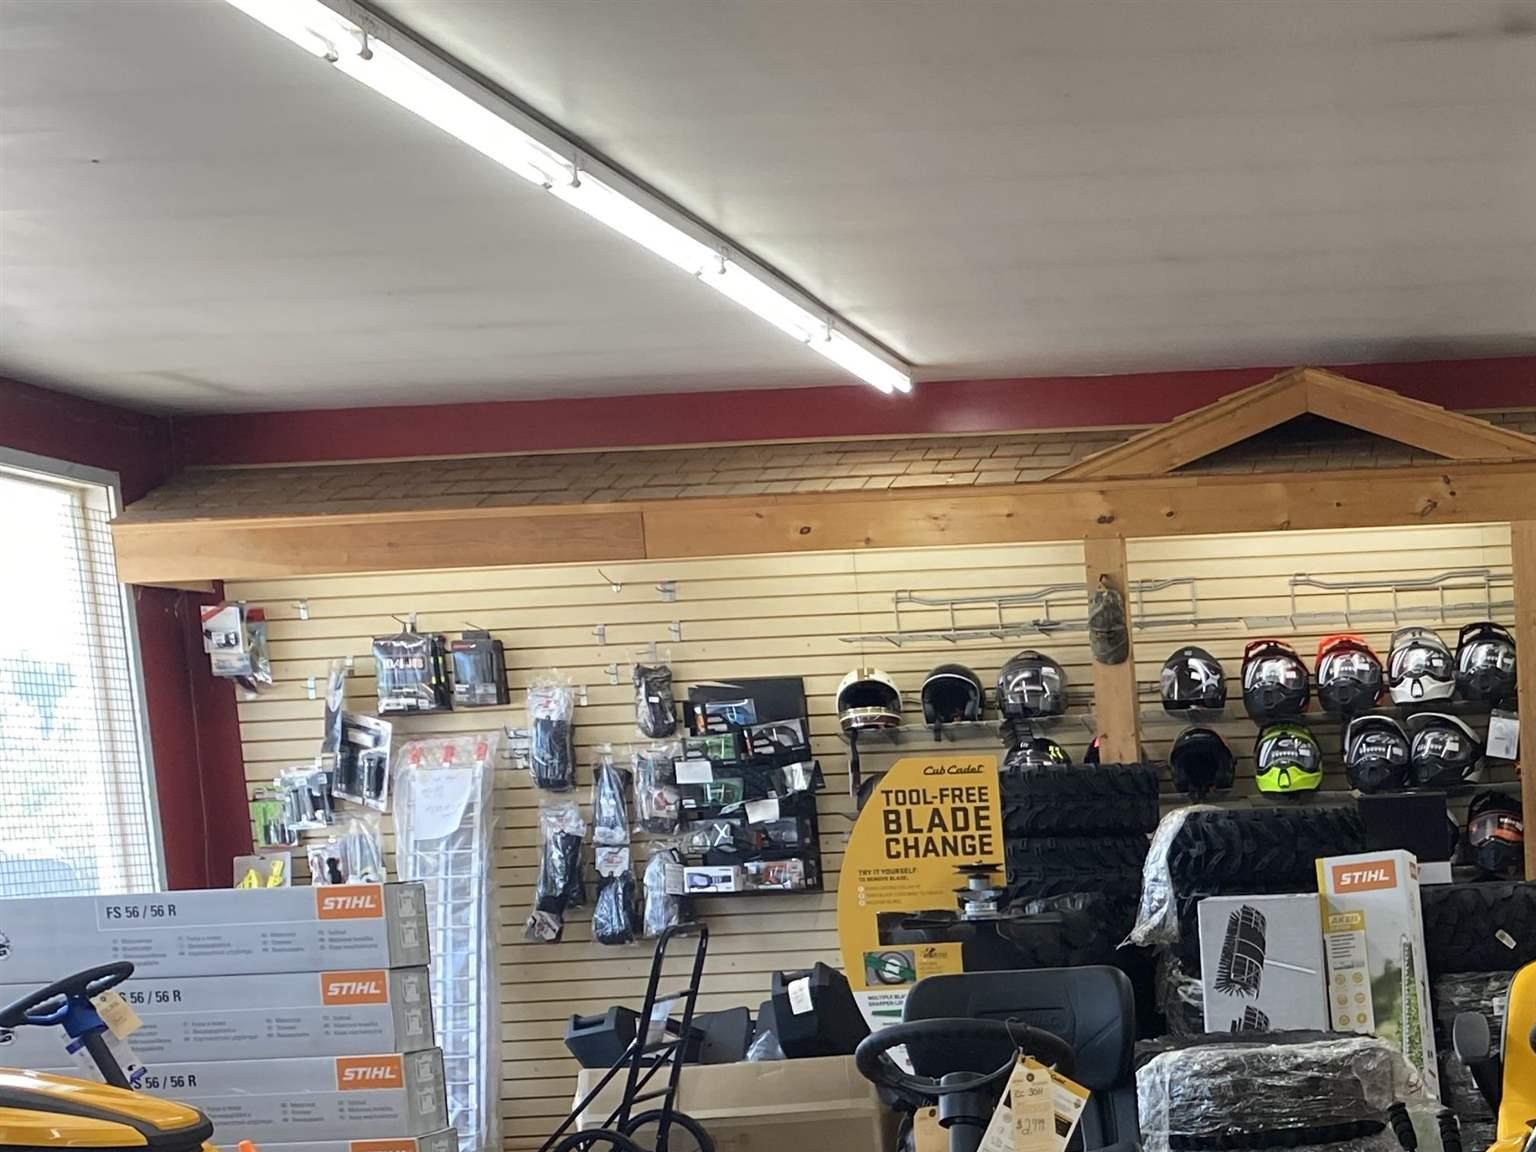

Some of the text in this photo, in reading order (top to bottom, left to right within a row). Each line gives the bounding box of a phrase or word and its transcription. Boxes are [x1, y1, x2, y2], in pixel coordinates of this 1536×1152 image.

[923, 764, 985, 777] Cub Cadet
[881, 786, 989, 808] TOOL-FREE
[882, 805, 992, 835] BLADE
[885, 834, 994, 860] CHANGE
[1339, 868, 1391, 886] STIHL
[322, 895, 378, 911] STIHL
[106, 906, 122, 919] FS
[125, 905, 140, 918] 56
[149, 904, 165, 918] 56
[167, 904, 177, 917] R
[327, 981, 381, 996] STIHL
[130, 991, 144, 1004] 56
[154, 990, 169, 1003] 56
[173, 989, 182, 1002] R
[341, 1066, 397, 1081] STIHL
[145, 1077, 160, 1090] 56
[170, 1076, 185, 1089] 56
[188, 1075, 197, 1088] R
